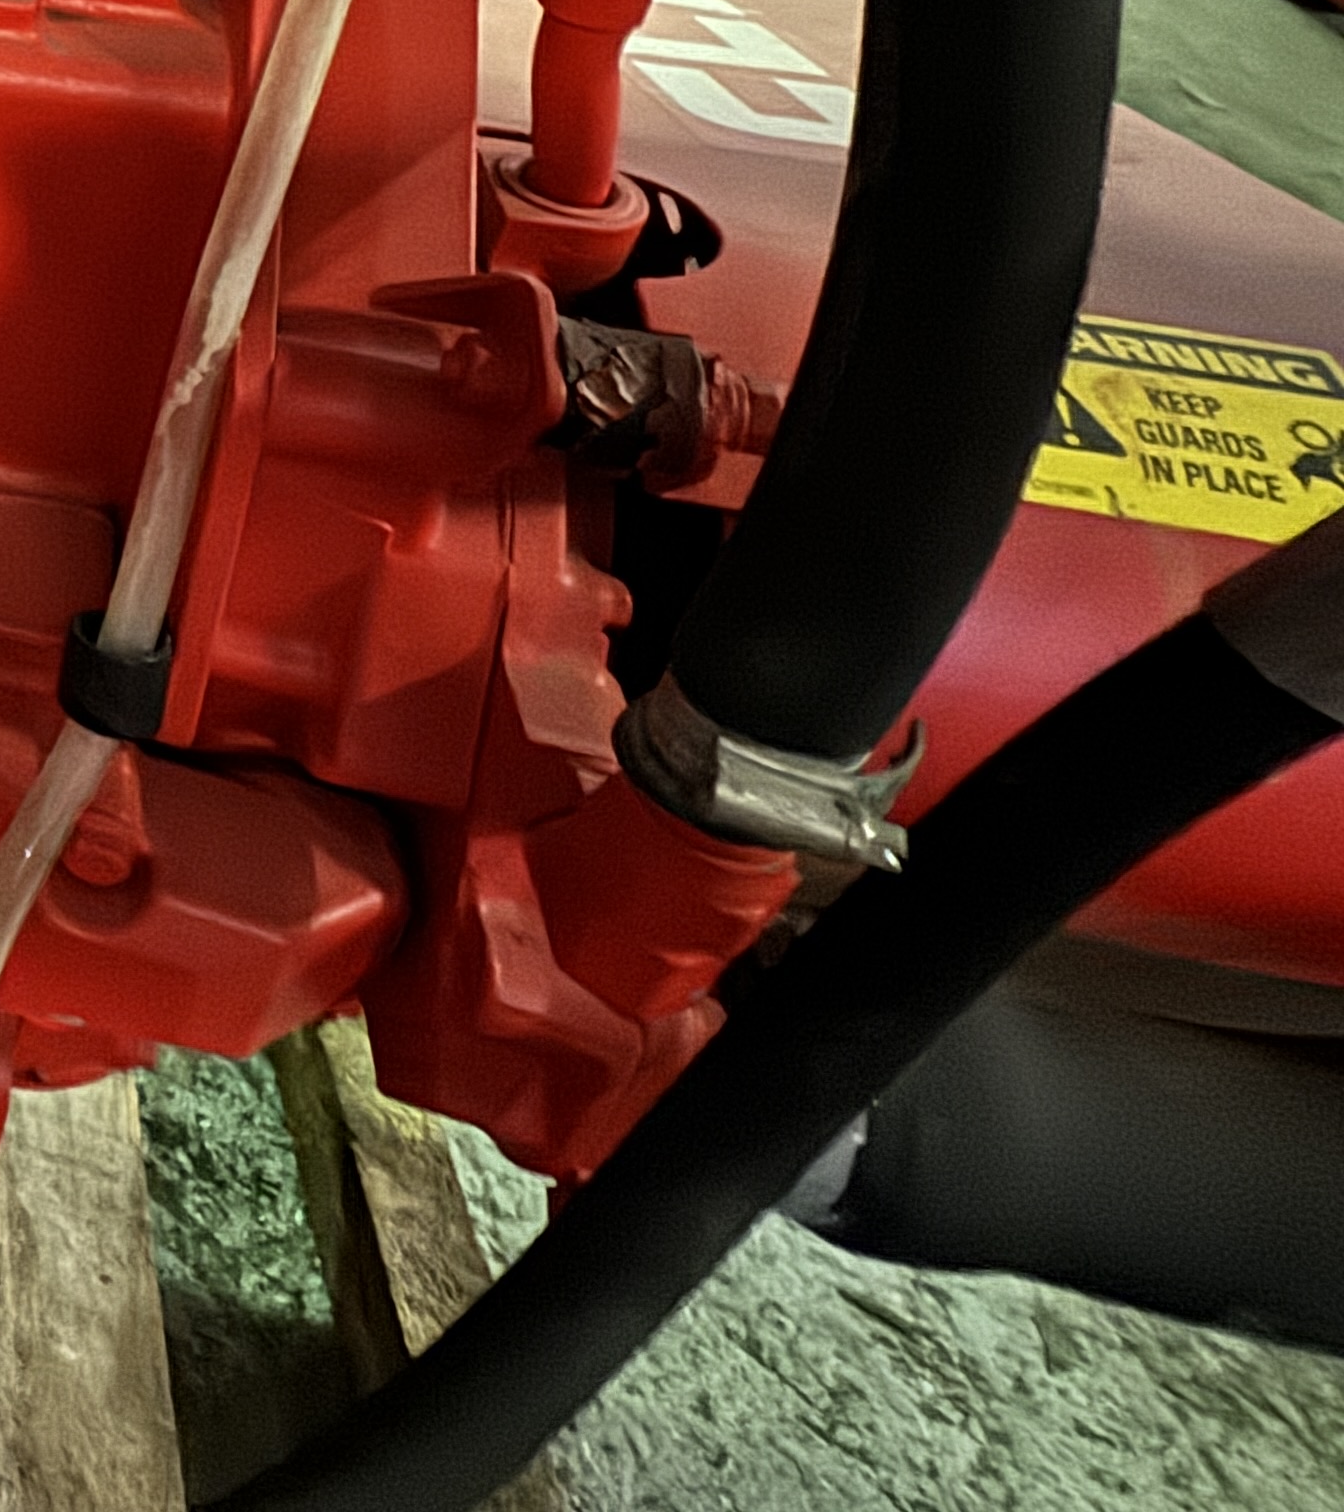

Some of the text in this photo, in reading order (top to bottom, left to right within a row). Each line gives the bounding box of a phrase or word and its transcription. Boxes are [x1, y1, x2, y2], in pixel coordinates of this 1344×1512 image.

[1071, 329, 1331, 391] ARNING
[1145, 390, 1223, 419] KEEP
[1135, 419, 1268, 462] GUARDS
[1140, 454, 1287, 504] IN PLACE
